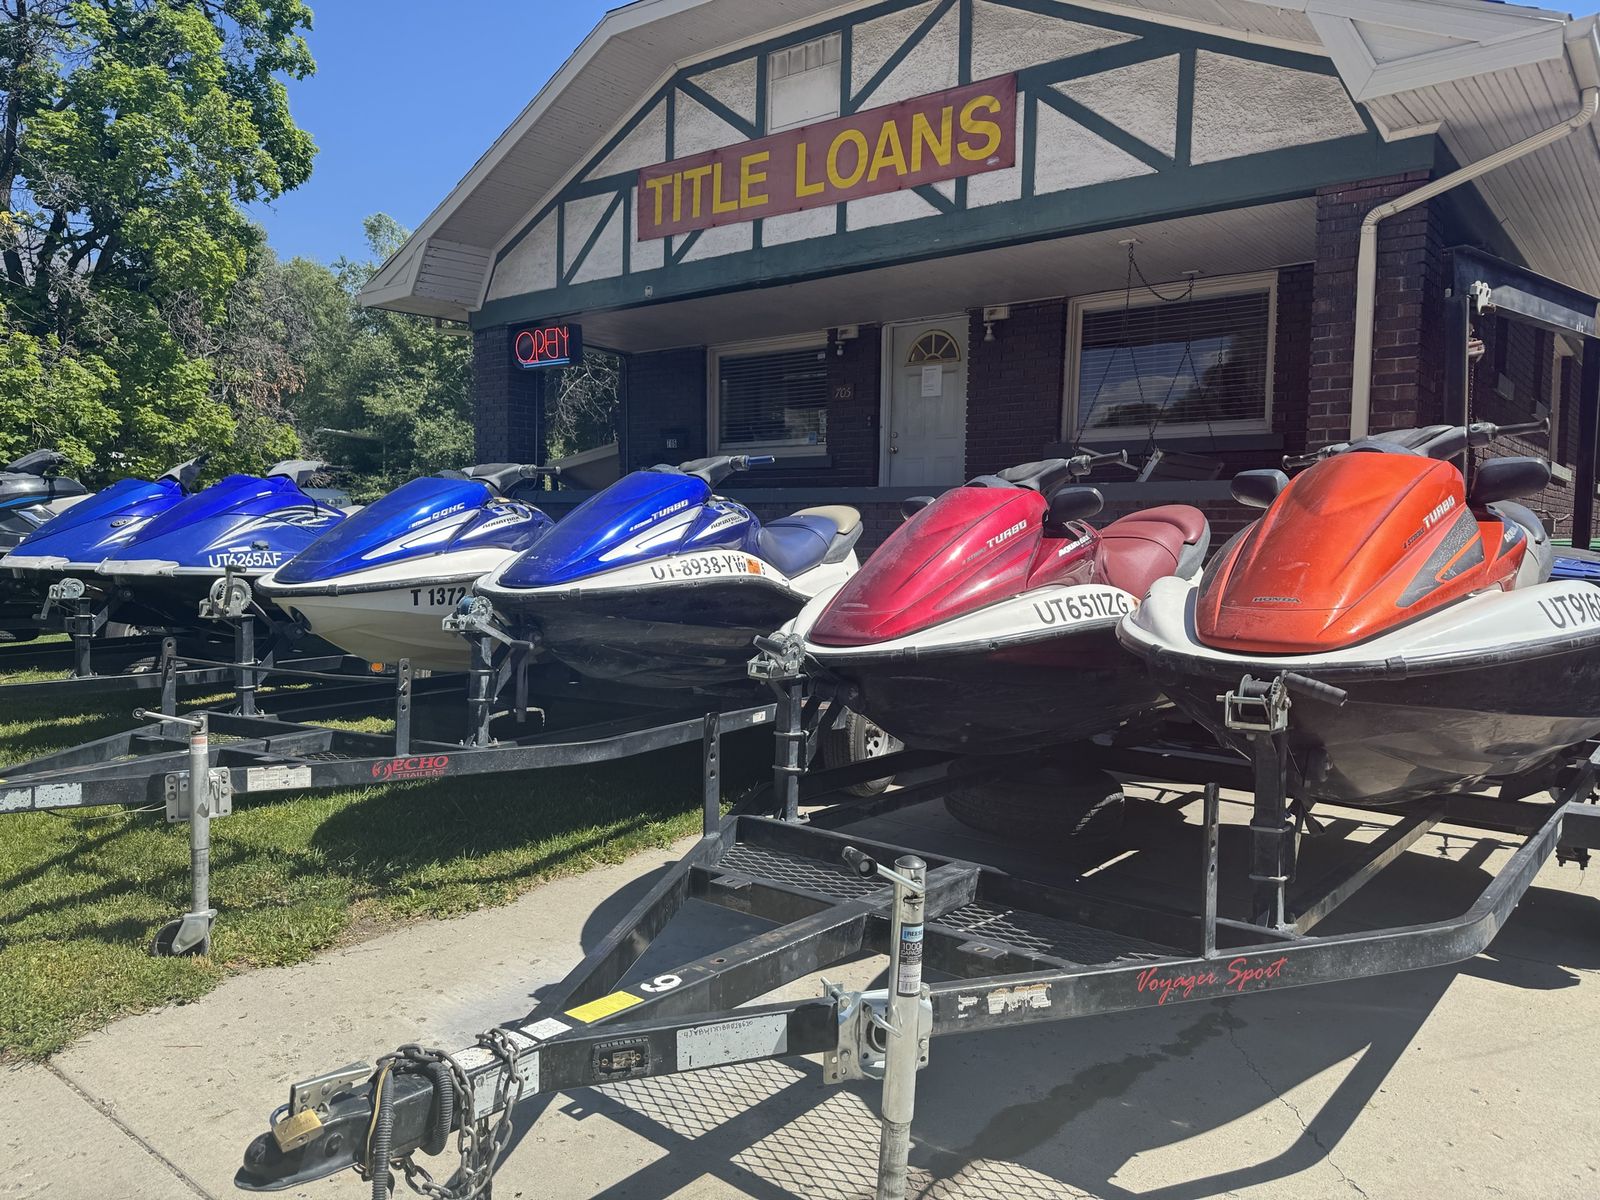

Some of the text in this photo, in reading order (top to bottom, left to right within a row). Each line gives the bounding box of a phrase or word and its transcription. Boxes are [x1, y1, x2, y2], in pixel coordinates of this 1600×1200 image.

[645, 94, 1002, 226] TITLE LOANS
[515, 325, 570, 363] OPEN
[651, 498, 689, 521] TURBO
[1422, 495, 1456, 529] TURBO
[985, 518, 1028, 548] TURBO
[208, 552, 282, 569] UT6265AF
[1033, 592, 1129, 625] UT6511ZG
[1253, 596, 1301, 604] HONDA
[392, 755, 449, 770] ECHO
[397, 770, 445, 778] TRAILERS
[1136, 955, 1289, 1006] Voyager Sport
